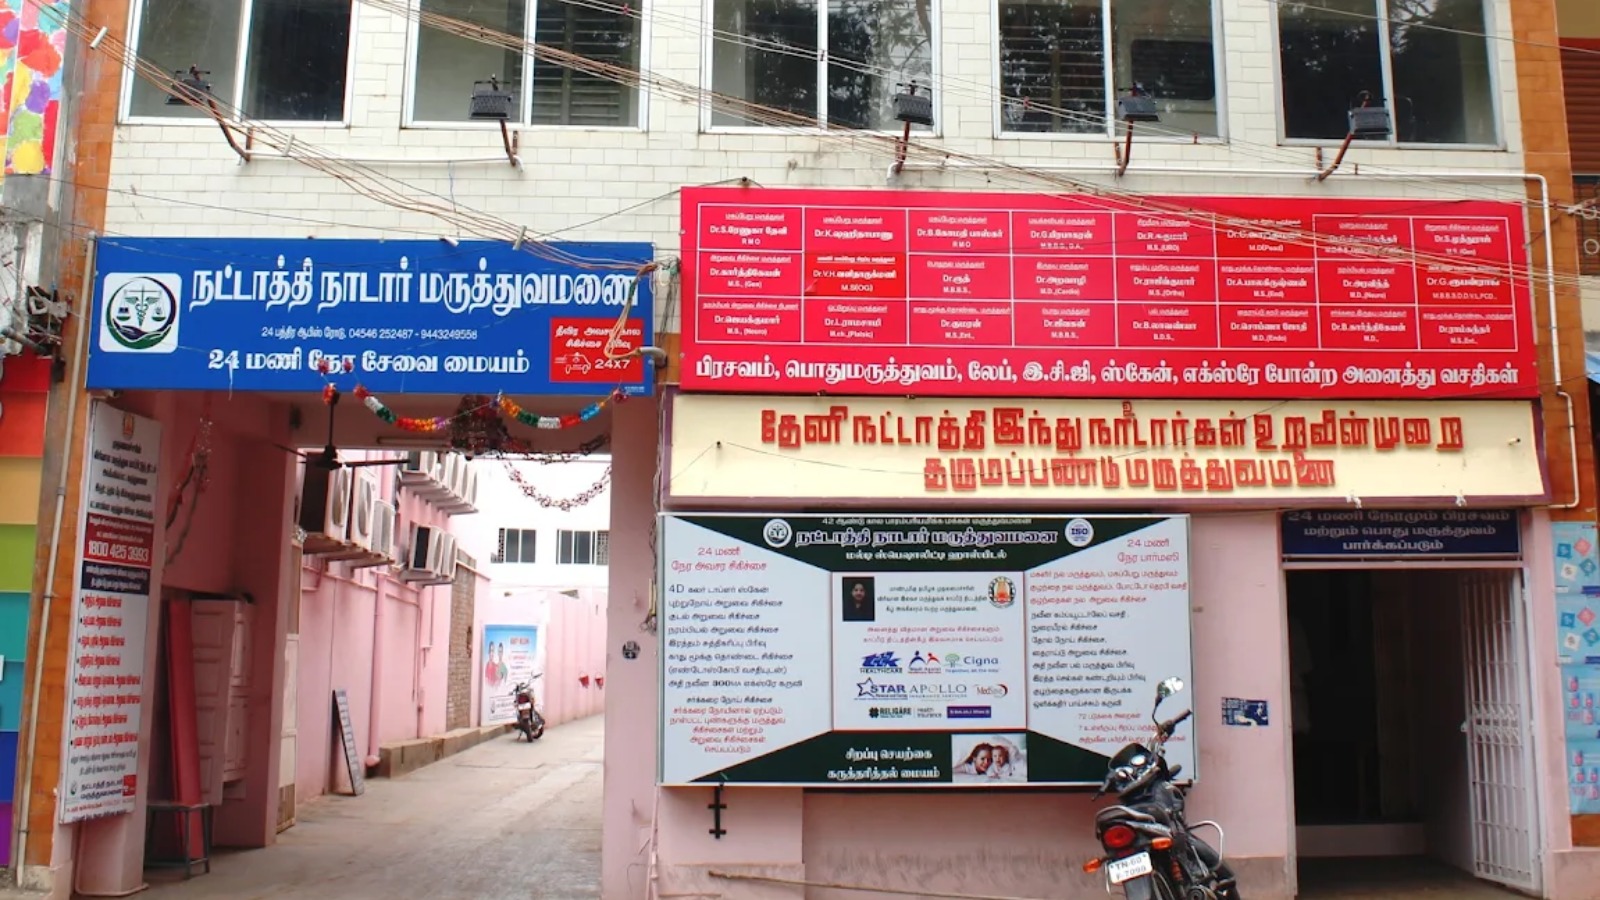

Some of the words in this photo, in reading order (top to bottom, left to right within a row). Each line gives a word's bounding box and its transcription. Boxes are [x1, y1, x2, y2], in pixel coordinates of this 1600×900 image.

[189, 255, 314, 313] நட்டாத்தி
[317, 256, 413, 314] நாடார்
[262, 327, 273, 337] 24
[348, 328, 377, 338] 04546
[378, 328, 413, 339] 252487
[208, 349, 239, 370] 24
[246, 346, 302, 370] மணி
[362, 350, 438, 372] சேவை
[444, 348, 530, 373] மையம்
[595, 359, 630, 369] 24X7
[696, 354, 781, 380] பிரசவம்,
[968, 358, 1018, 382] லேப்,
[1101, 359, 1179, 384] ஸ்கேன்,
[1183, 360, 1259, 386] எக்ஸ்ரே
[1265, 360, 1338, 388] போன்ற
[1342, 361, 1437, 389] அனைத்து
[1440, 361, 1518, 387] வசதிகள்
[761, 405, 848, 448] தேனி
[853, 409, 986, 452] நட்டாத்தி
[1088, 410, 1246, 447] நாடார்கள்
[795, 527, 870, 547] நட்டாத்தி
[872, 527, 930, 547] நாடார்
[932, 527, 1058, 547] மருத்துவமனை
[1304, 526, 1359, 538] மற்றும்
[1362, 526, 1409, 537] பொது
[1144, 538, 1169, 547] மணி
[698, 547, 712, 555] 24
[715, 547, 740, 555] மணி
[1117, 552, 1137, 565] நேர
[671, 560, 691, 574] நேர
[728, 561, 767, 571] சிகிச்சை
[669, 584, 684, 593] 4D
[964, 655, 999, 667] Cigna
[871, 684, 906, 693] STAR
[909, 684, 967, 694] APOLLO
[845, 747, 878, 761] சிறப்பு
[900, 766, 940, 778] மையம்
